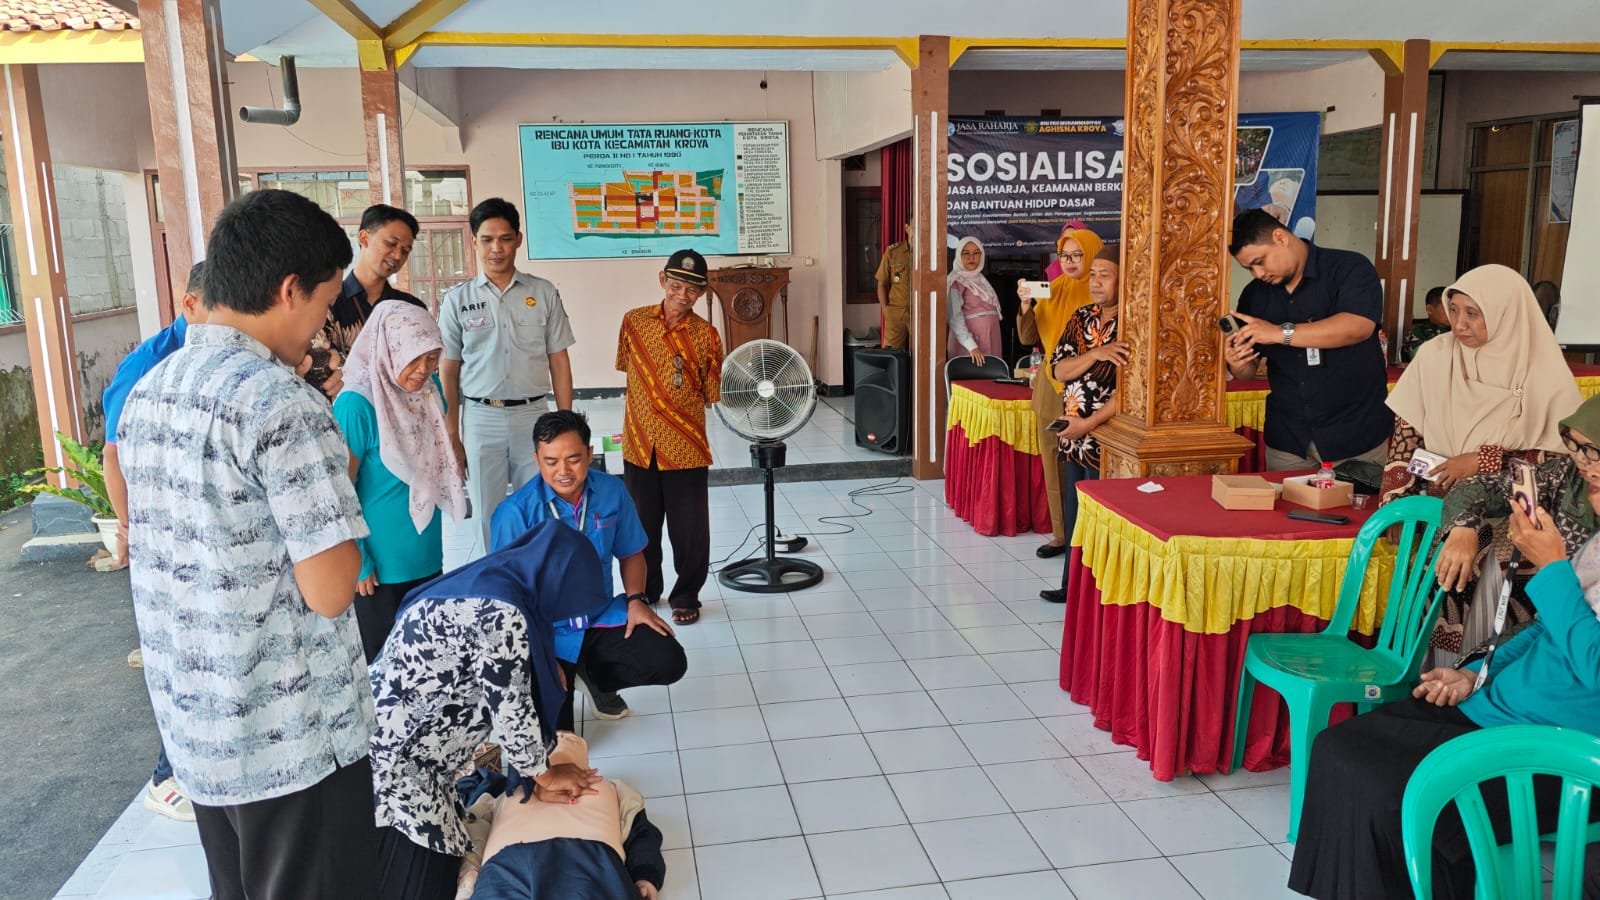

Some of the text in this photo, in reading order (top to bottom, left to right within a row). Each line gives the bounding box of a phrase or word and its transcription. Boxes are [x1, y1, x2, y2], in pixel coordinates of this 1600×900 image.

[956, 121, 1018, 132] JASA RAHARJA
[1039, 125, 1076, 133] AGHISNA
[535, 128, 722, 140] RENCANA UMUM TATA RUANG KOTA
[551, 139, 709, 150] IBU KOTA KECAMATAN KROYA
[947, 185, 974, 195] JASA
[975, 184, 1030, 195] RAHARJA,
[1031, 183, 1093, 193] KEAMANAN
[947, 198, 1096, 211] DAN BANTUAN HIDUP DASAR
[461, 301, 487, 313] ARIF
